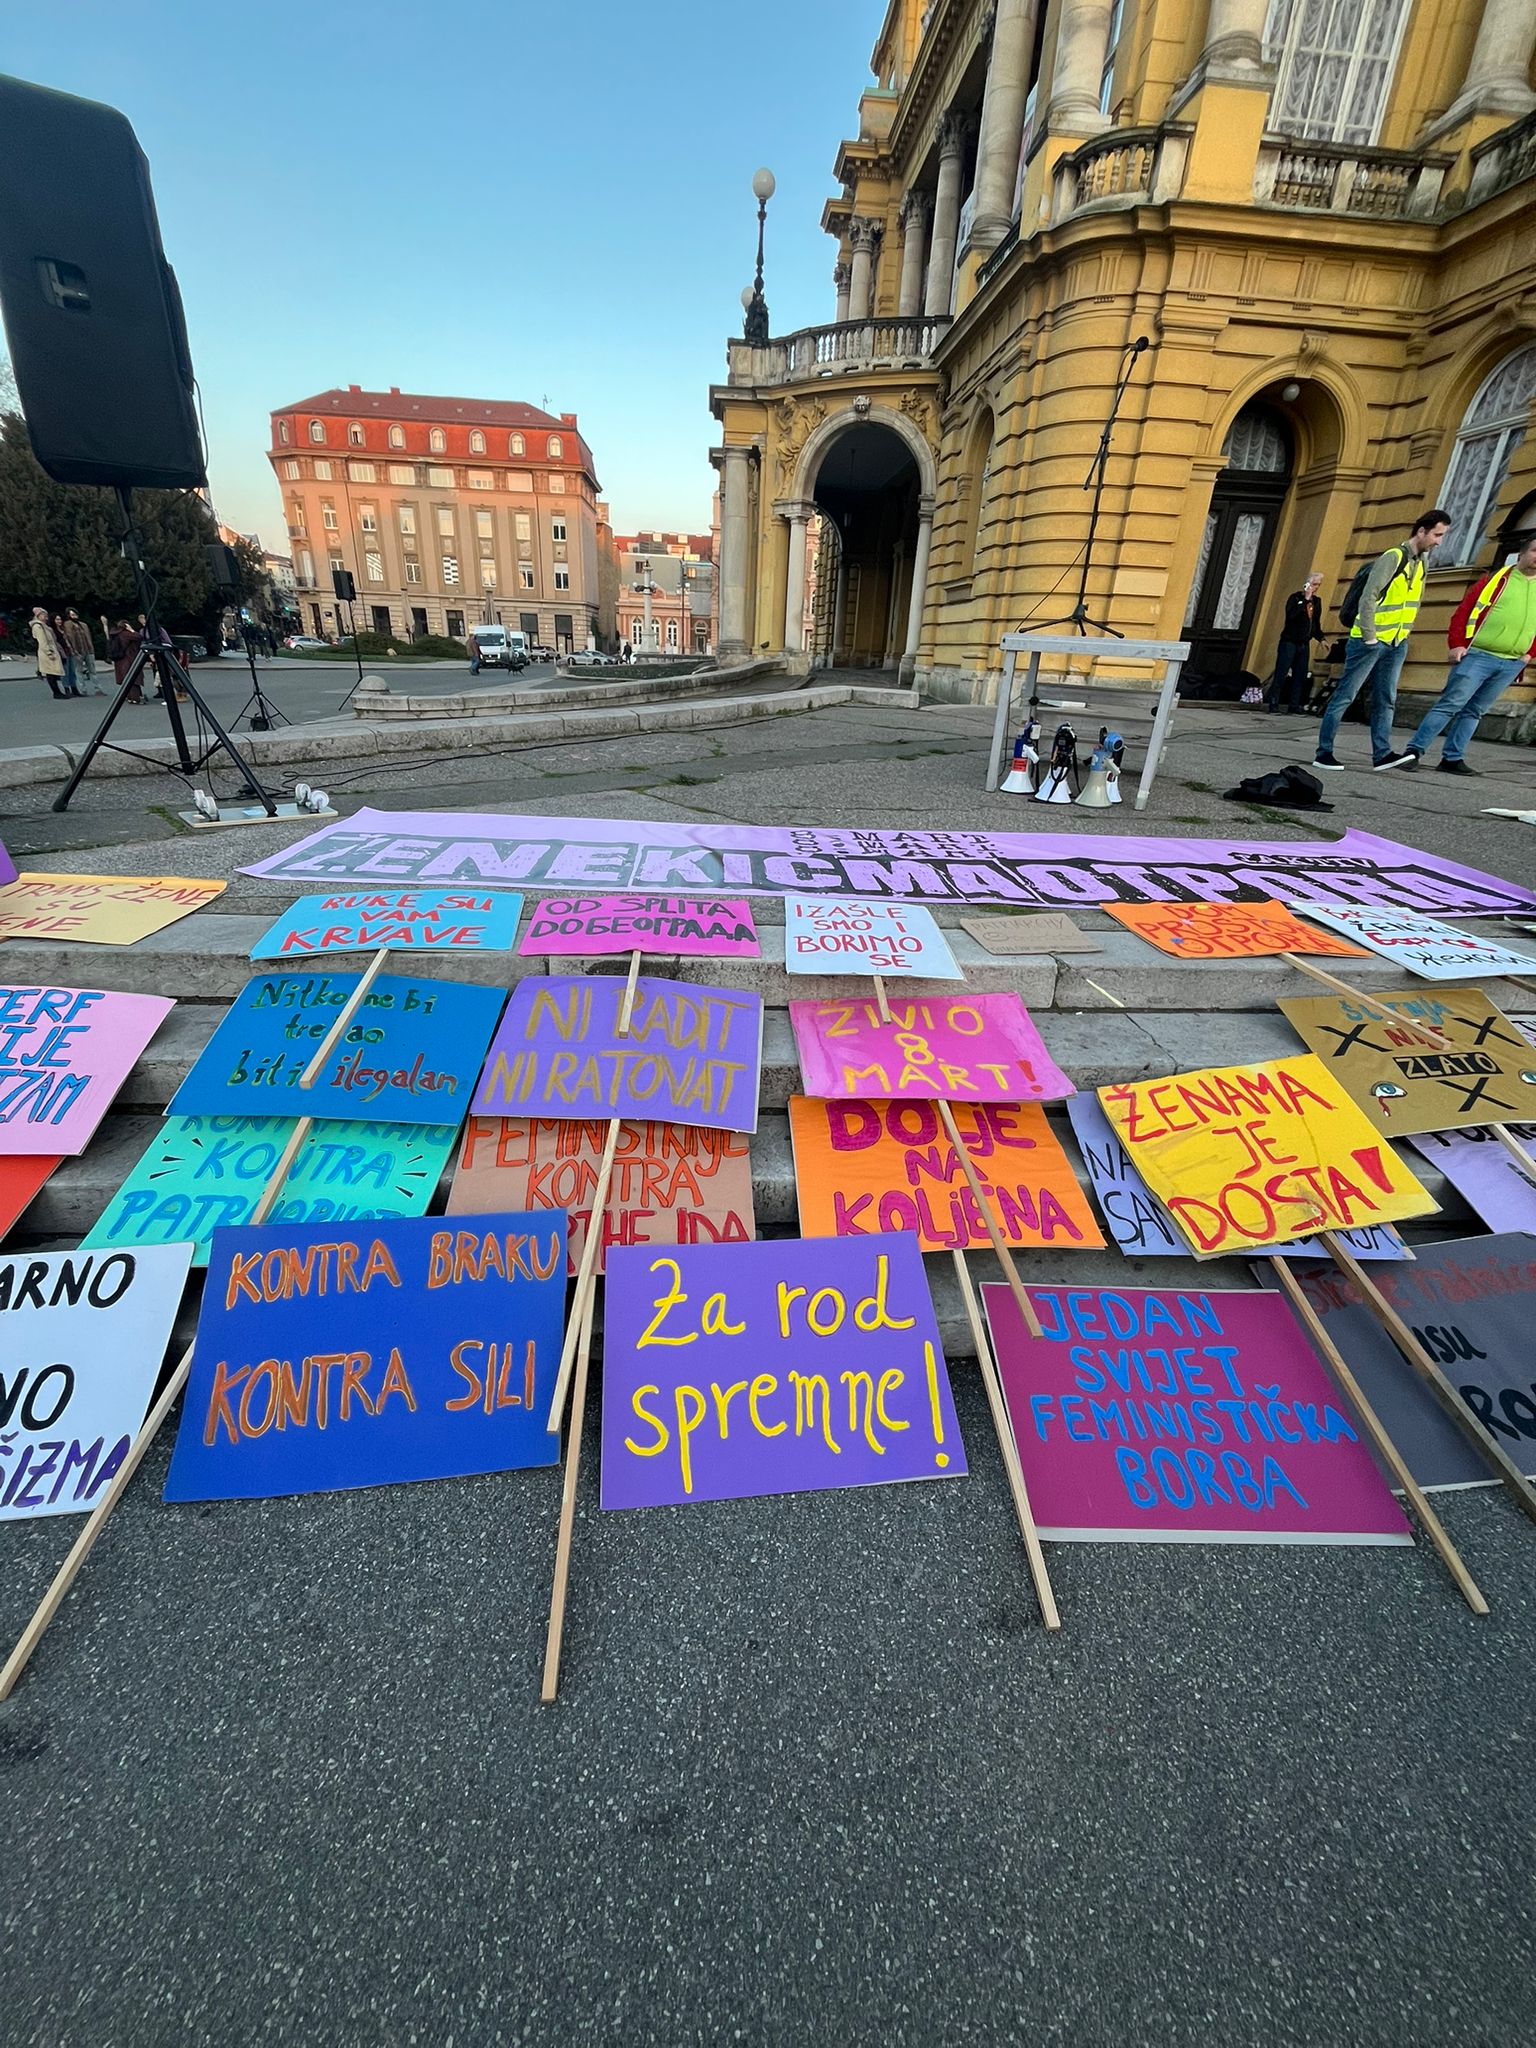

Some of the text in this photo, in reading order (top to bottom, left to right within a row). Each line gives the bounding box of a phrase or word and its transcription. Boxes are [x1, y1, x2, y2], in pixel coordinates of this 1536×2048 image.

[1, 881, 221, 906] TRANS ŽENE
[36, 900, 103, 911] SU
[320, 894, 492, 912] RUKE SU
[545, 897, 737, 919] OD SPLITA
[795, 902, 908, 919] IZAŠLE
[0, 912, 89, 933] ENE
[360, 909, 442, 922] VAM
[813, 919, 908, 934] SMO I
[1134, 917, 1323, 940] PROSTOR
[280, 926, 488, 952] KRVAVE
[795, 935, 924, 954] BORIMO
[1175, 932, 1346, 955] OTPORA
[869, 954, 913, 968] SE
[250, 978, 438, 1015] Nitko ne bi
[283, 1013, 386, 1044] treao
[524, 986, 753, 1054] NI RADIT
[0, 1025, 91, 1067] IJE
[1396, 1054, 1497, 1077] ZLATO
[330, 1048, 459, 1102] ilegalan
[481, 1049, 747, 1115] NI RATOVAT
[1104, 1070, 1338, 1143] ŽENAMA
[194, 1138, 397, 1190] KONTRA
[904, 1146, 989, 1186] NA
[1212, 1120, 1300, 1180] JE
[525, 1156, 704, 1210] KONTRA
[834, 1184, 1084, 1249] KOLJENA
[226, 1231, 561, 1310] KONTRA BRAKU
[636, 1254, 916, 1350] Za rod
[1034, 1291, 1224, 1342] JEDAN
[203, 1339, 536, 1447] KONTRA SILI
[1069, 1346, 1246, 1398] SVIJET
[624, 1339, 950, 1494] spremne!
[1030, 1383, 1359, 1445] FEMINISTIČKA
[1459, 1383, 1536, 1441] RO
[1115, 1446, 1309, 1512] BORBA
